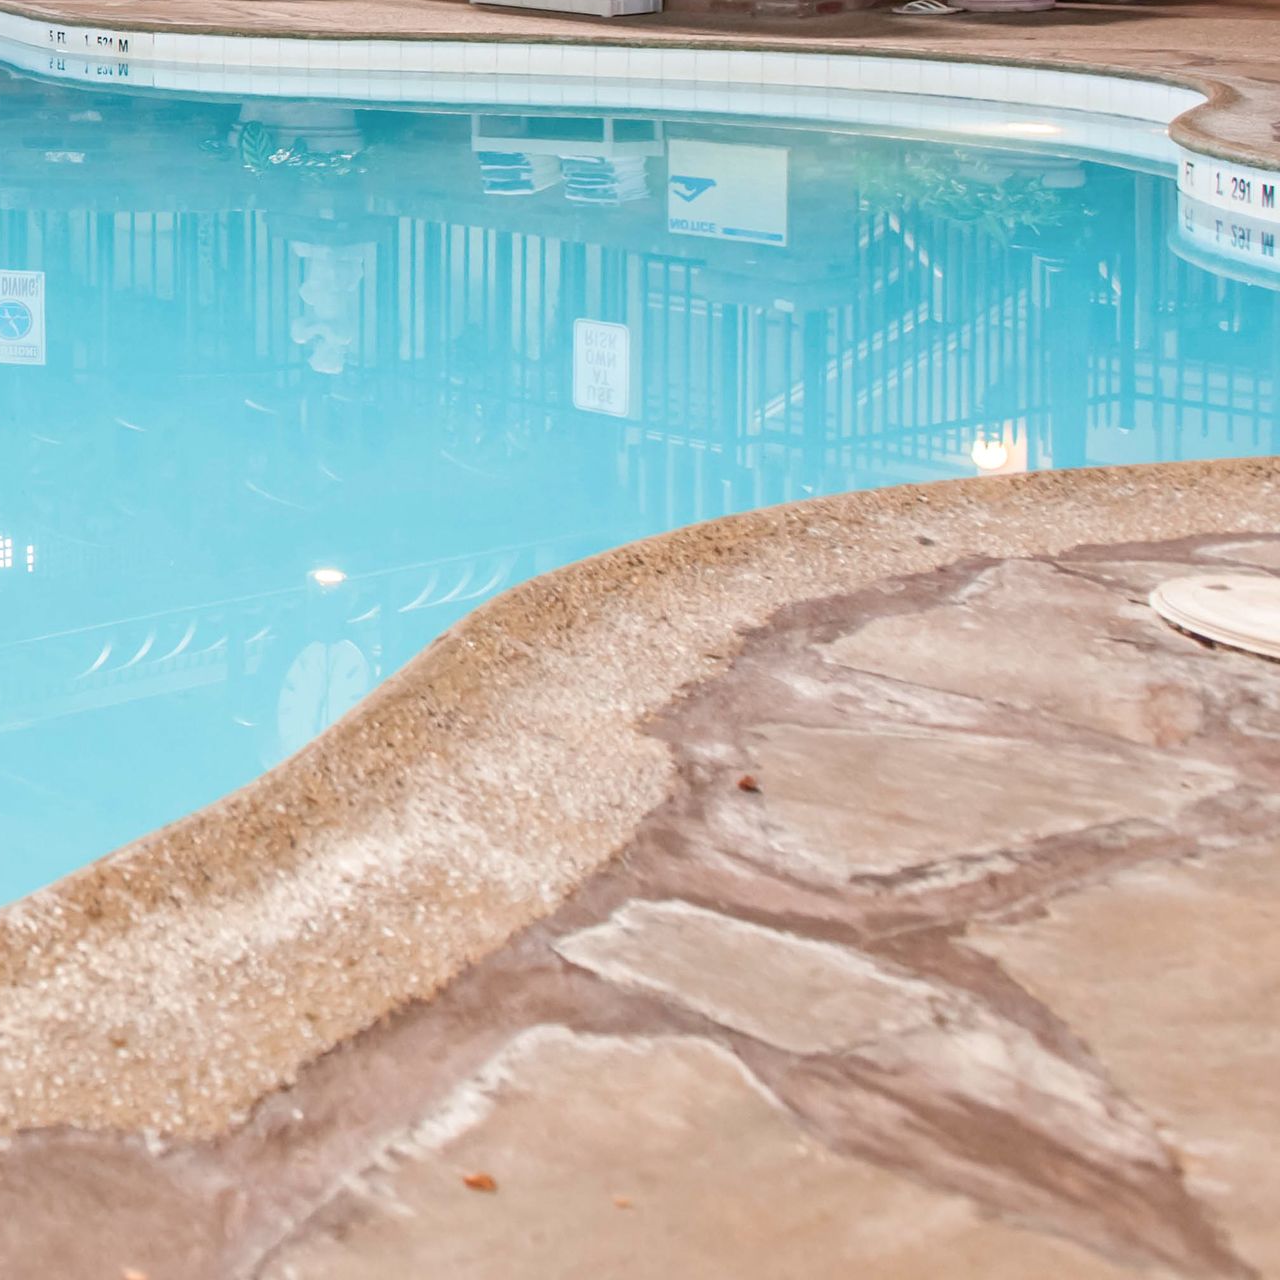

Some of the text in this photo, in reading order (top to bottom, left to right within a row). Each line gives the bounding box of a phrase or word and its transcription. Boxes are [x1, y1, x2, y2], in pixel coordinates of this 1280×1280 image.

[118, 39, 129, 53] M
[1231, 176, 1251, 203] 291
[1261, 183, 1275, 208] M
